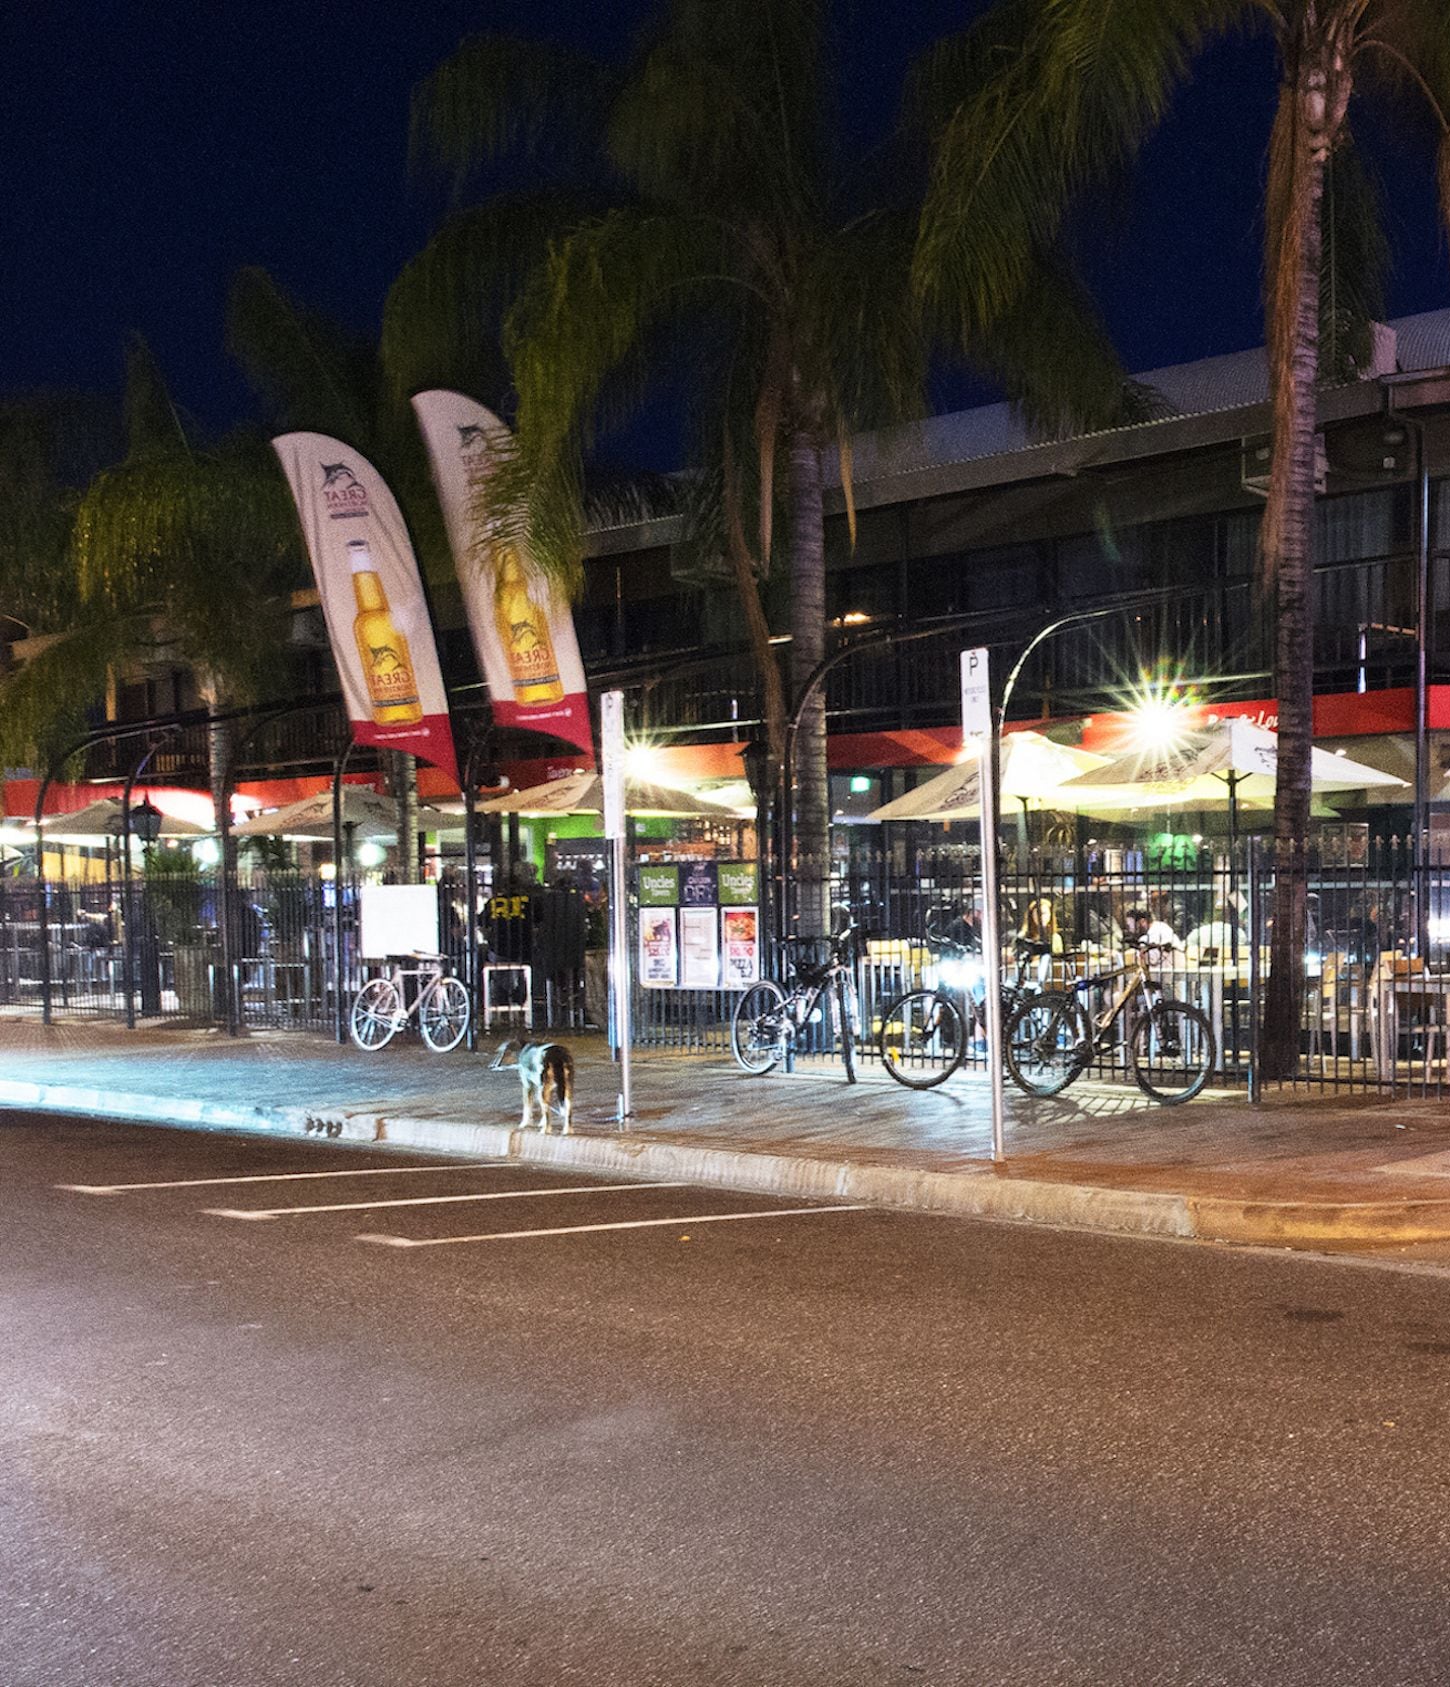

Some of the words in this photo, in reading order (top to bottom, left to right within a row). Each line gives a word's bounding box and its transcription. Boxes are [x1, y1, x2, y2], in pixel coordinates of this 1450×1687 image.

[969, 656, 979, 676] P
[643, 875, 675, 889] Uncles
[722, 873, 755, 887] Uncles
